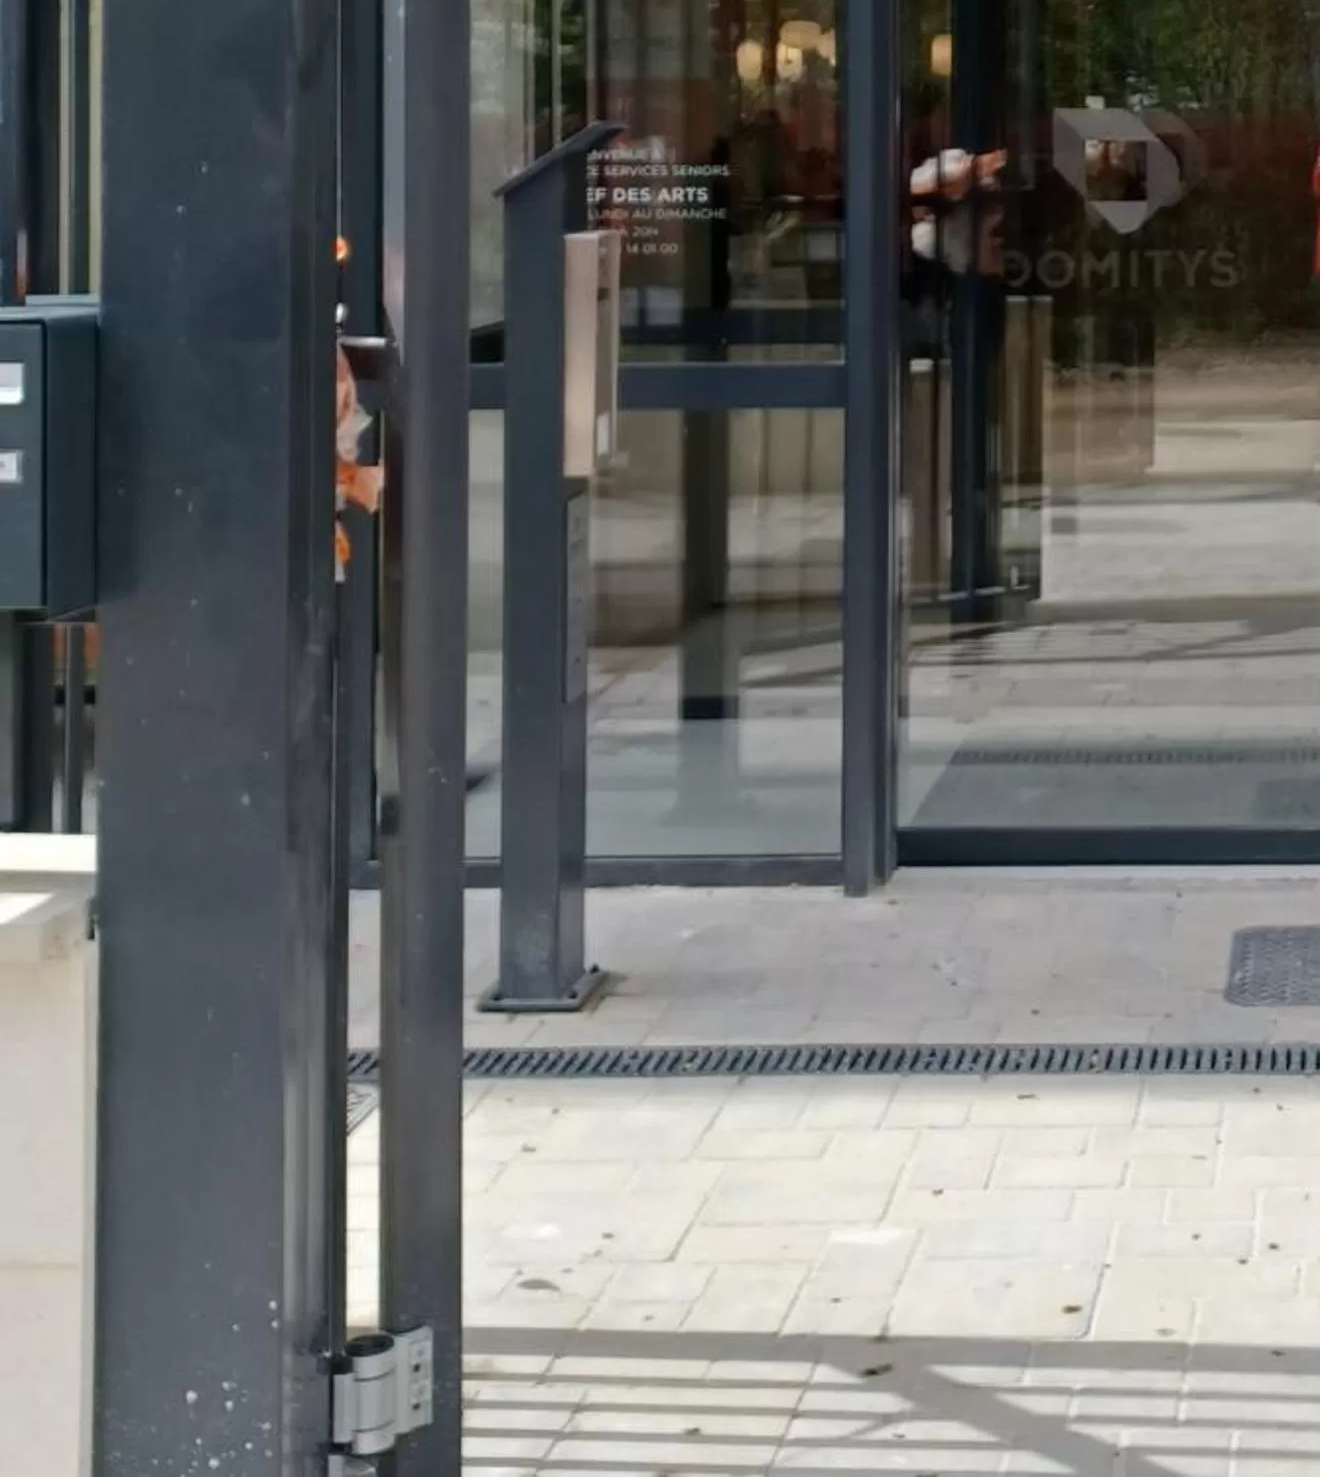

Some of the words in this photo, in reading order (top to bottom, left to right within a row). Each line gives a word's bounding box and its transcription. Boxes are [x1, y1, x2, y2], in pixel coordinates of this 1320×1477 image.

[604, 164, 669, 178] SERVICES
[672, 163, 731, 177] SENIORS
[612, 187, 651, 204] DES
[656, 186, 709, 203] ARTS
[632, 208, 652, 220] AU
[655, 207, 727, 220] DIMANCHE
[1001, 249, 1239, 290] DOMITYS
